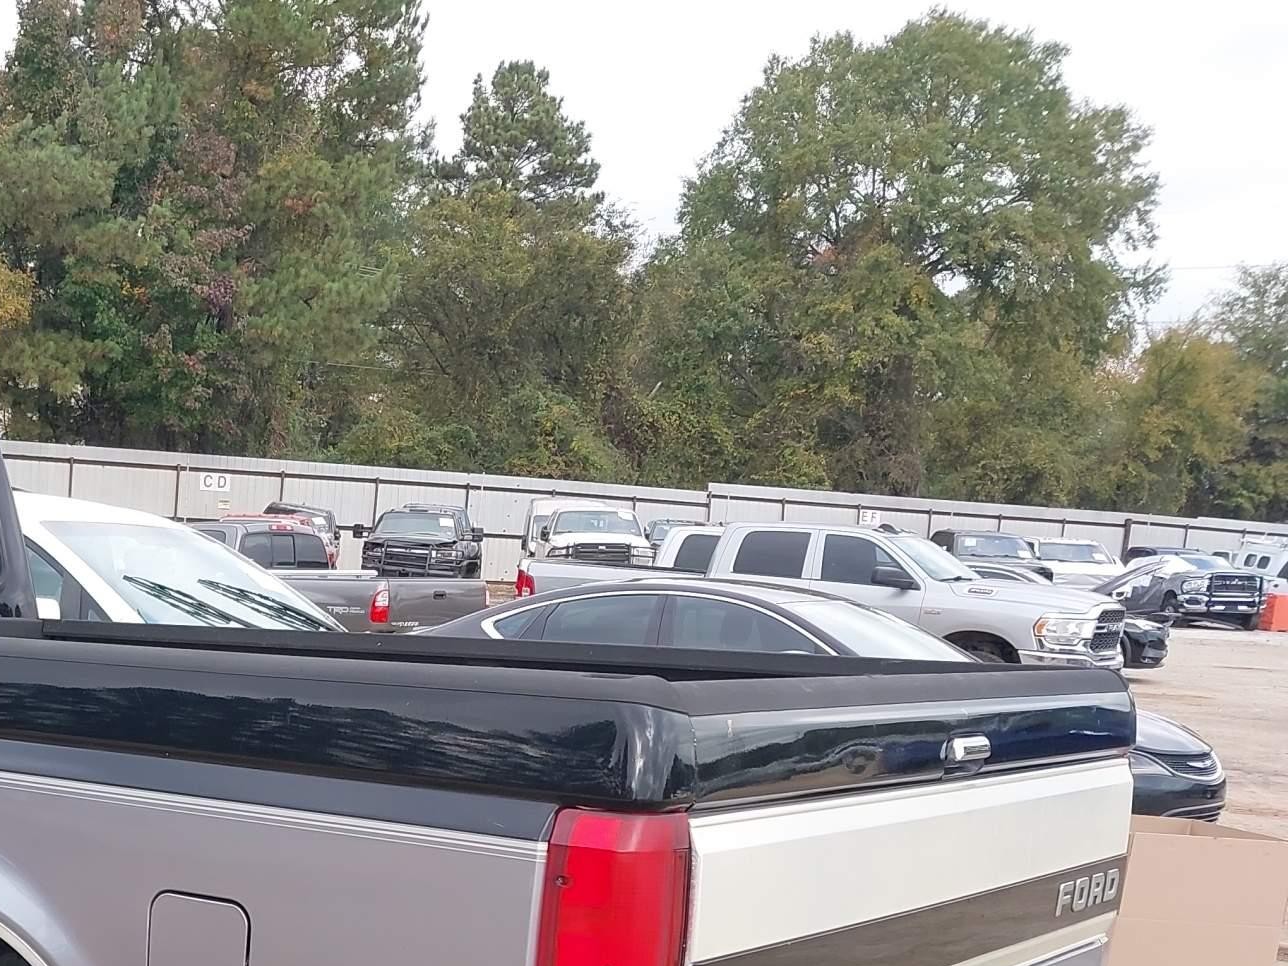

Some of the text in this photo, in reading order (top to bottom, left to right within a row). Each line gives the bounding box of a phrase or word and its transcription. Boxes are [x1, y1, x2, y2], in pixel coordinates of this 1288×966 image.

[203, 474, 227, 488] C D
[862, 511, 868, 522] E
[326, 605, 349, 615] TRD
[1055, 869, 1120, 917] FORD
